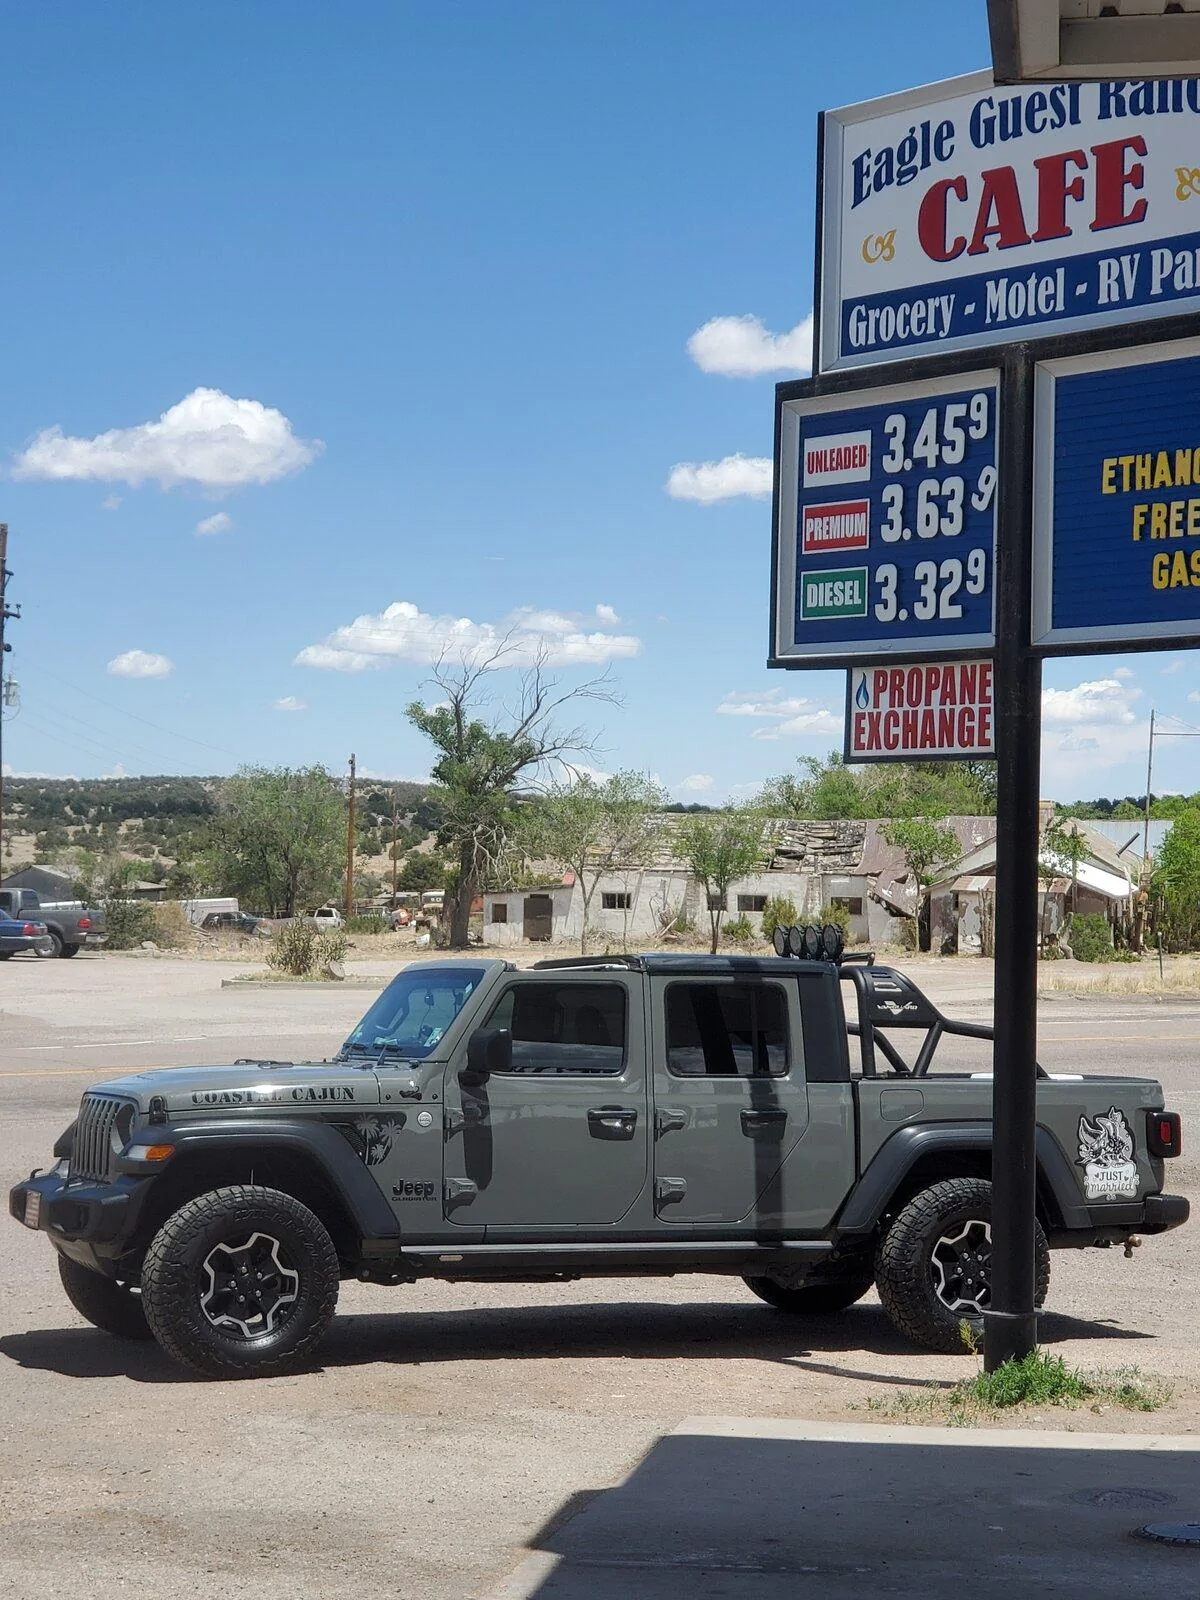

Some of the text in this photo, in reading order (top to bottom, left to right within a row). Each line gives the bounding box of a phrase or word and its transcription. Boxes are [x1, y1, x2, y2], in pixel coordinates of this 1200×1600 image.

[851, 120, 955, 209] Eagle
[969, 83, 1082, 148] Guest
[917, 135, 1149, 262] CAFE
[849, 293, 955, 347] Grocery
[985, 267, 1065, 324] Motel
[1098, 253, 1141, 304] RV
[806, 444, 868, 475] UNLEADED
[805, 512, 866, 542] PREMIUM
[1132, 498, 1200, 541] FREE
[806, 580, 862, 608] DIESEL
[872, 664, 992, 709] PROPANE
[854, 707, 992, 750] EXCHANGE
[292, 1087, 355, 1100] CAJUN
[392, 1178, 435, 1198] Jeep
[1091, 1177, 1134, 1192] married
[1099, 1171, 1123, 1181] JUST
